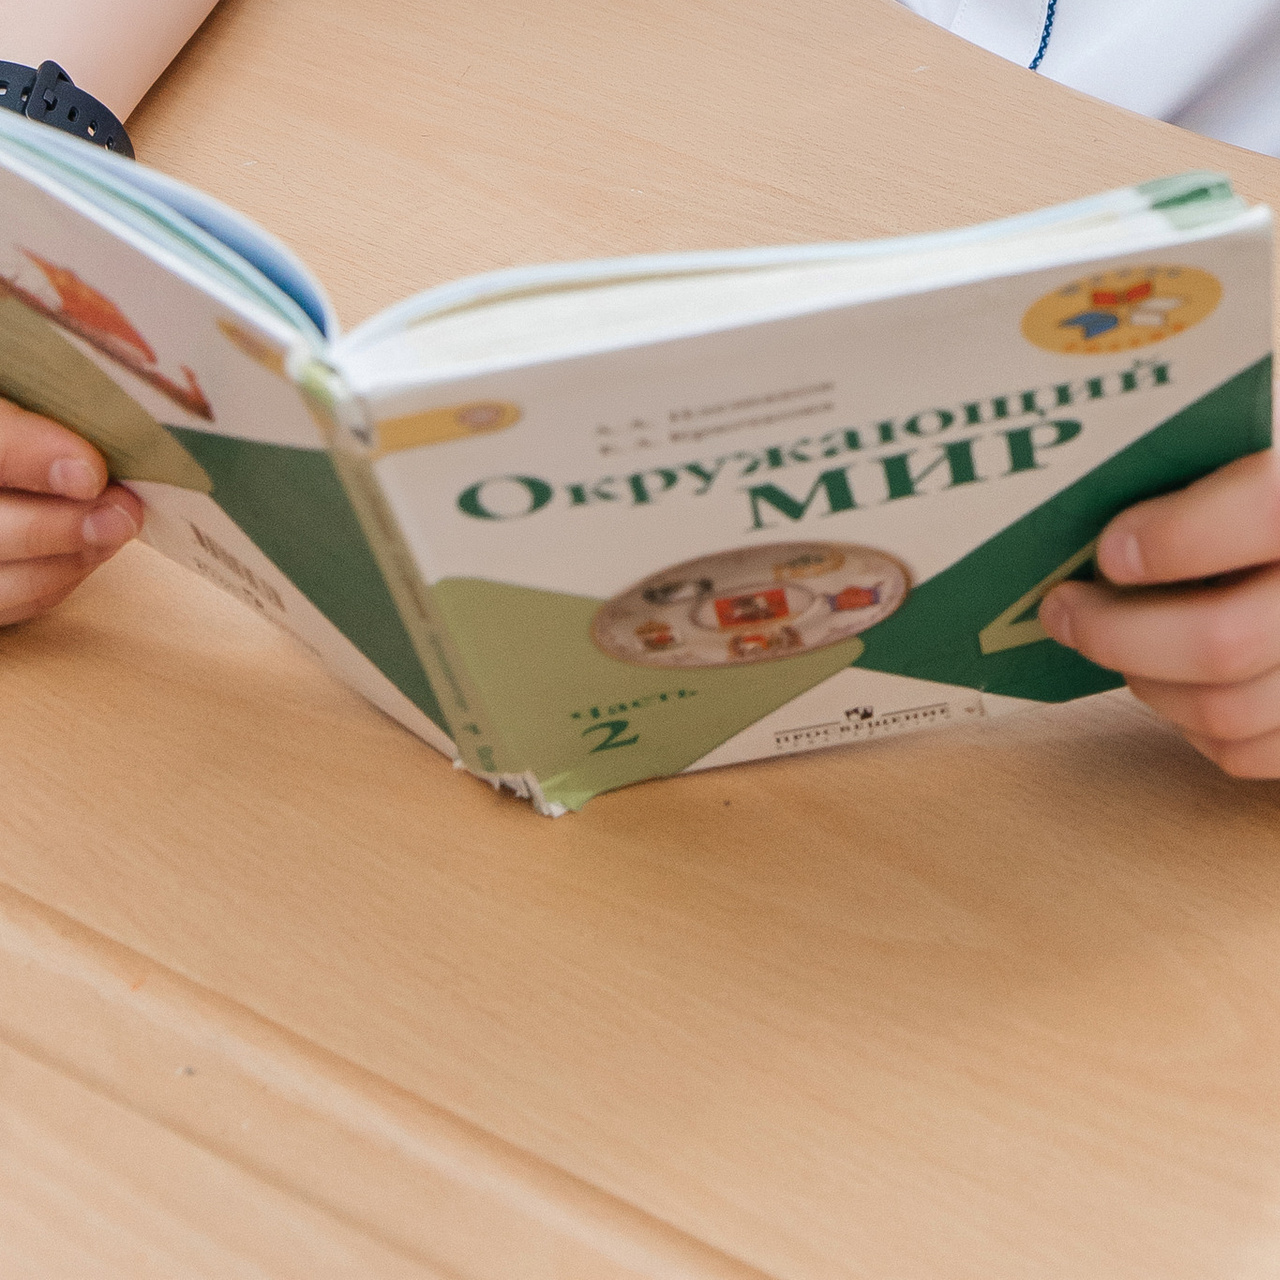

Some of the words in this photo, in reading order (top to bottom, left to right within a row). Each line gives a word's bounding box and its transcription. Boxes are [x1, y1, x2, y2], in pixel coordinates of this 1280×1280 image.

[456, 358, 1171, 521] Окружающий
[738, 419, 1083, 532] МИР
[582, 719, 640, 754] 2
